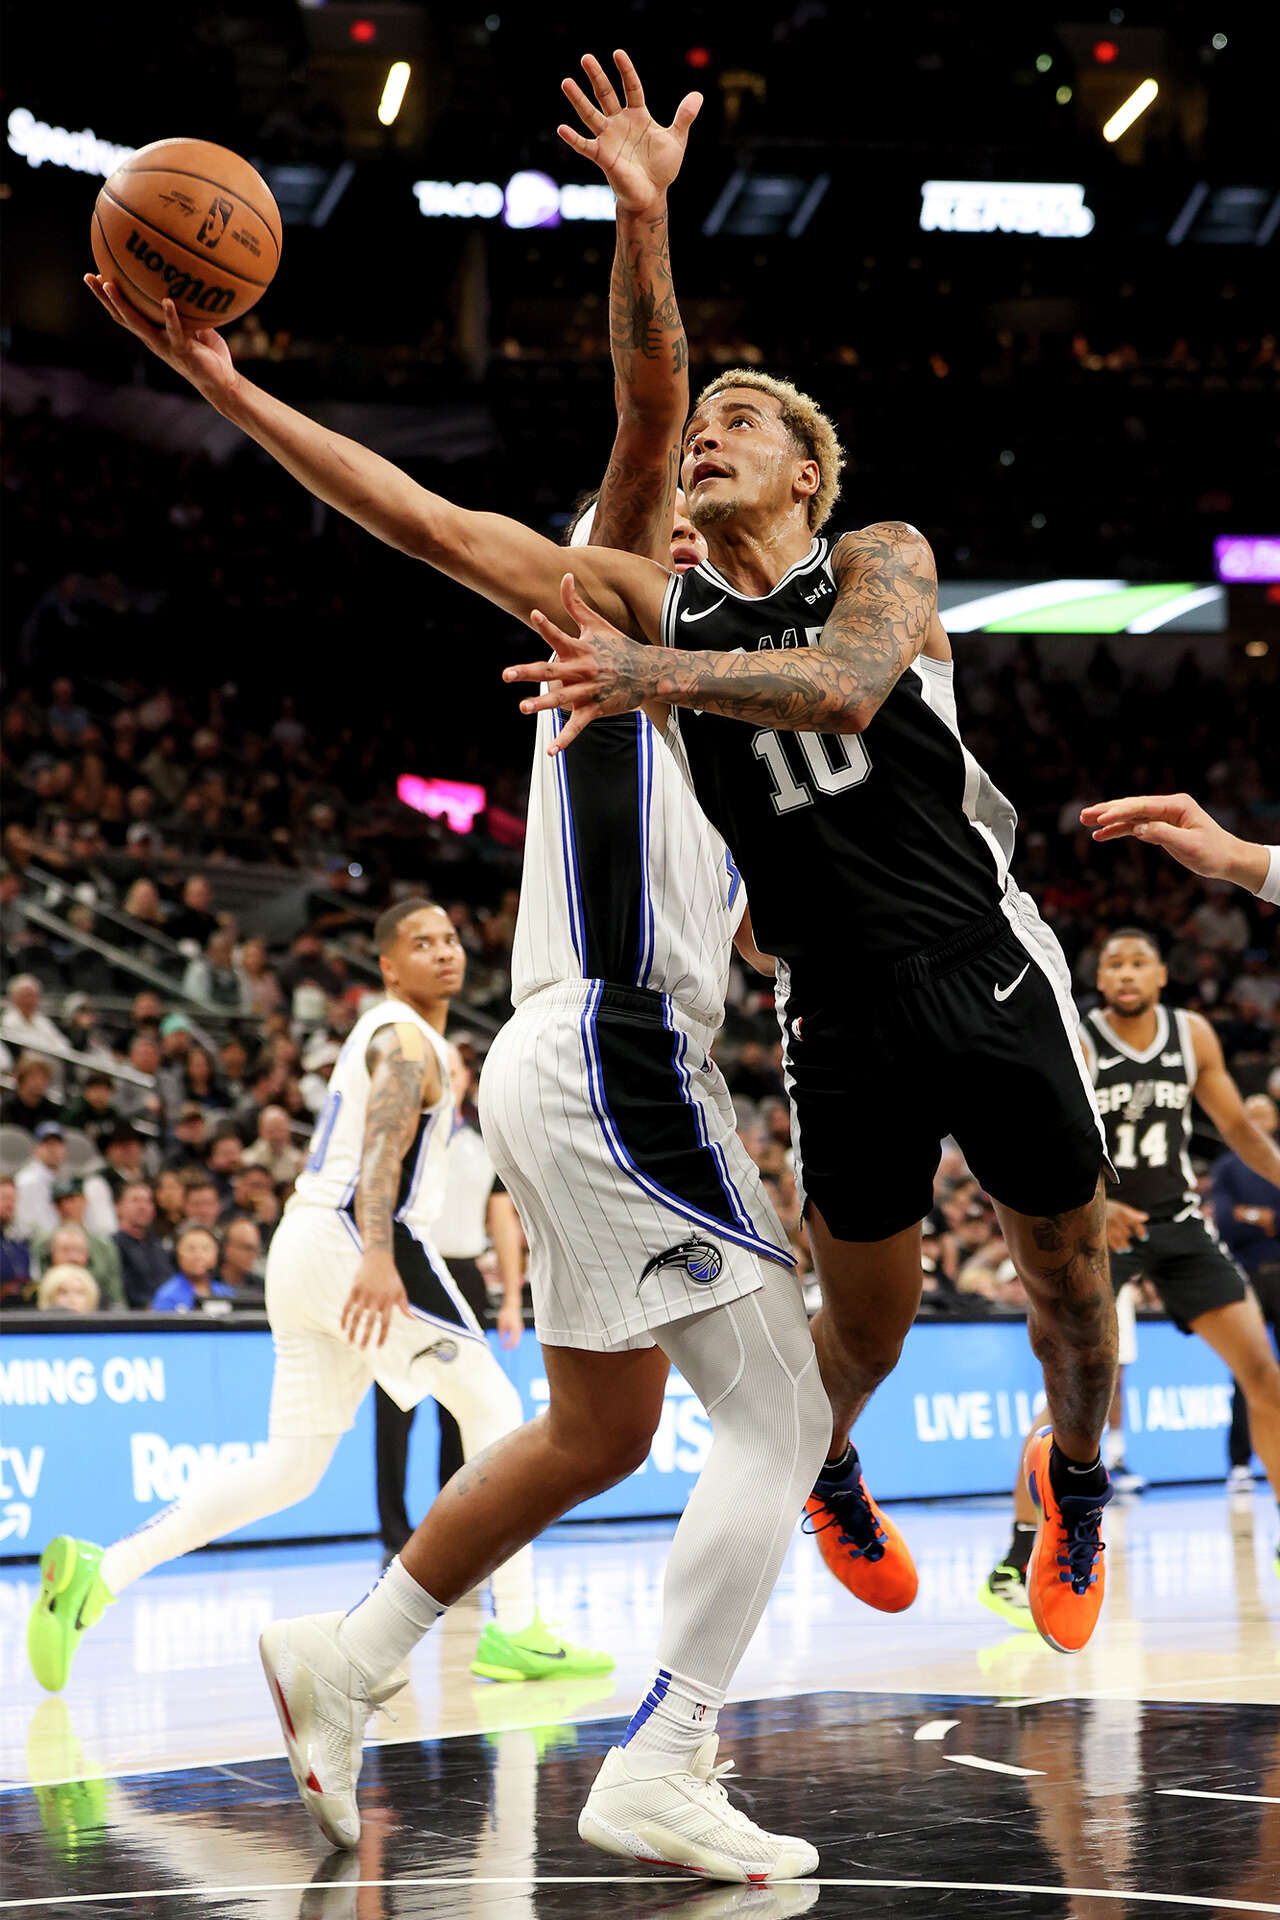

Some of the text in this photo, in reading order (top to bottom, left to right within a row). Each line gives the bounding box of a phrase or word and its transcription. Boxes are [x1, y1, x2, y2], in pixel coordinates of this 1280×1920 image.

[126, 230, 236, 313] Wilson
[751, 727, 873, 816] 10
[1112, 1121, 1168, 1169] 14
[102, 1356, 166, 1403] ON
[914, 1391, 994, 1441] LIVE
